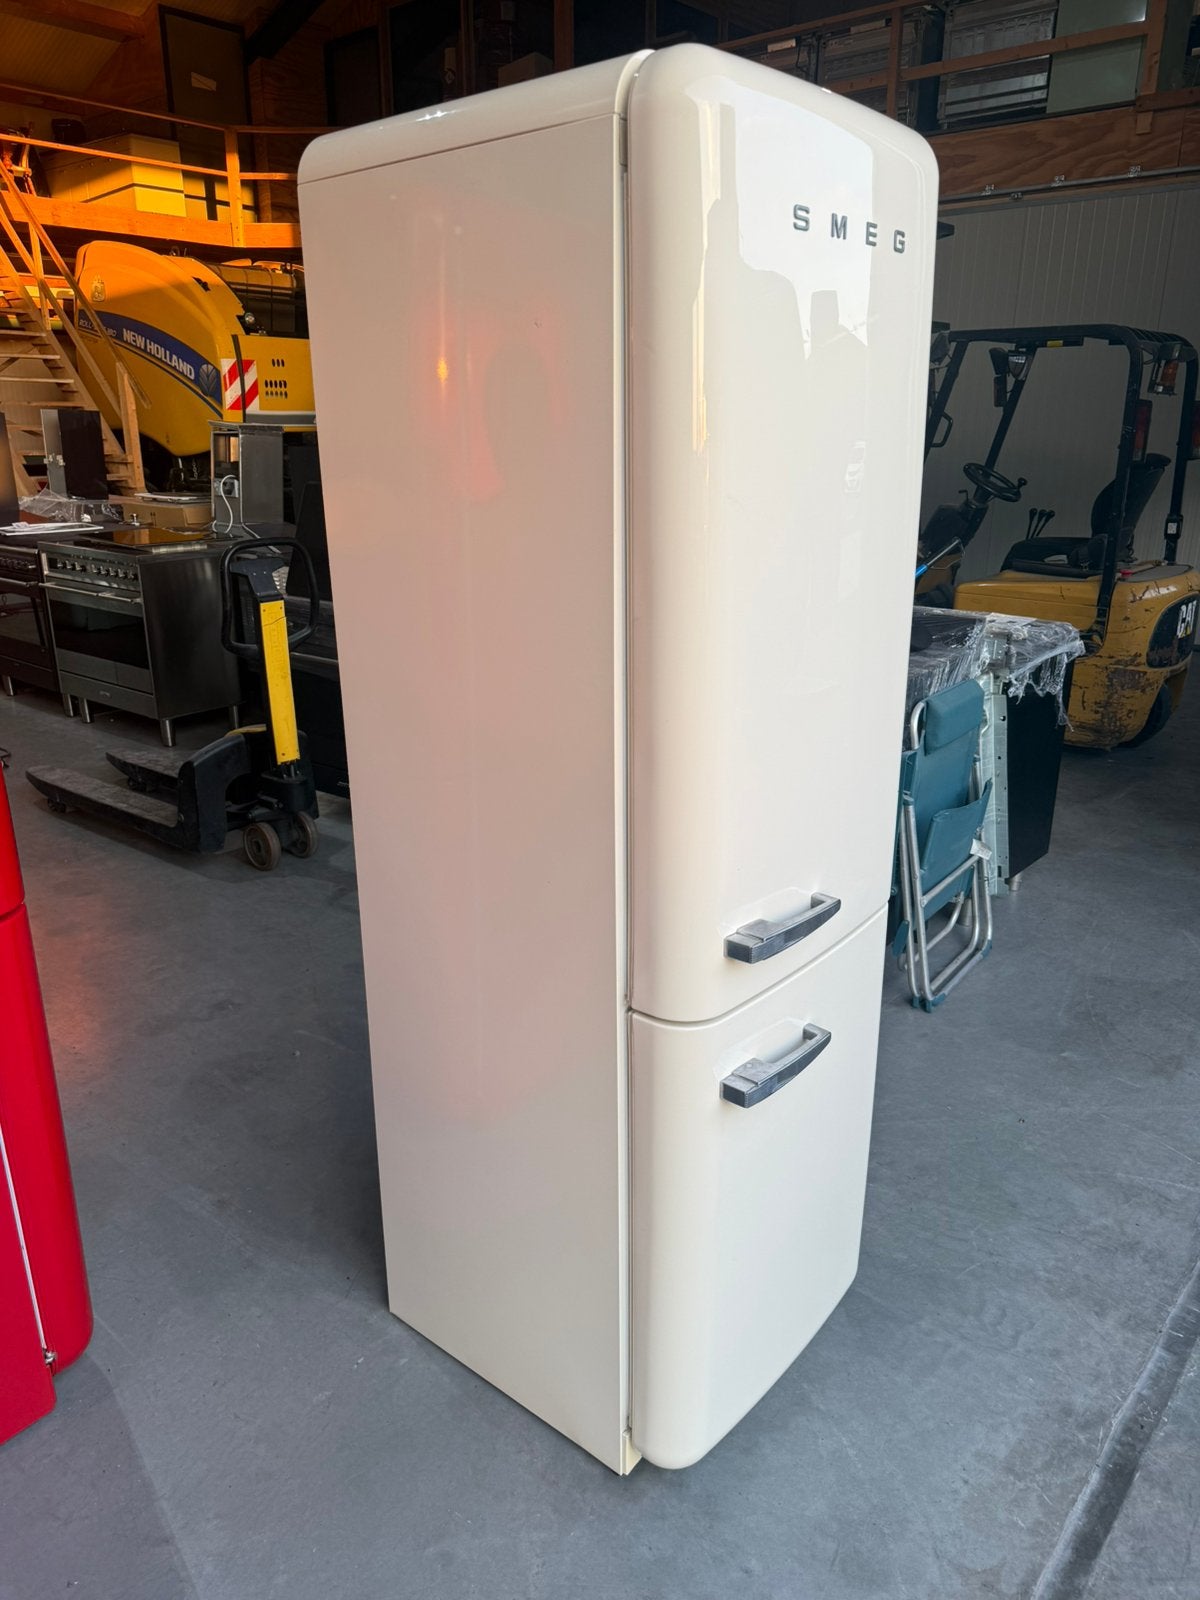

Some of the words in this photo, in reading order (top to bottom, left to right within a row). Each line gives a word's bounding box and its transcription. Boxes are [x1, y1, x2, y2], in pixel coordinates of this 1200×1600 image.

[793, 204, 906, 254] SMEG
[123, 328, 146, 350] NEW
[146, 339, 196, 380] HOLLAND
